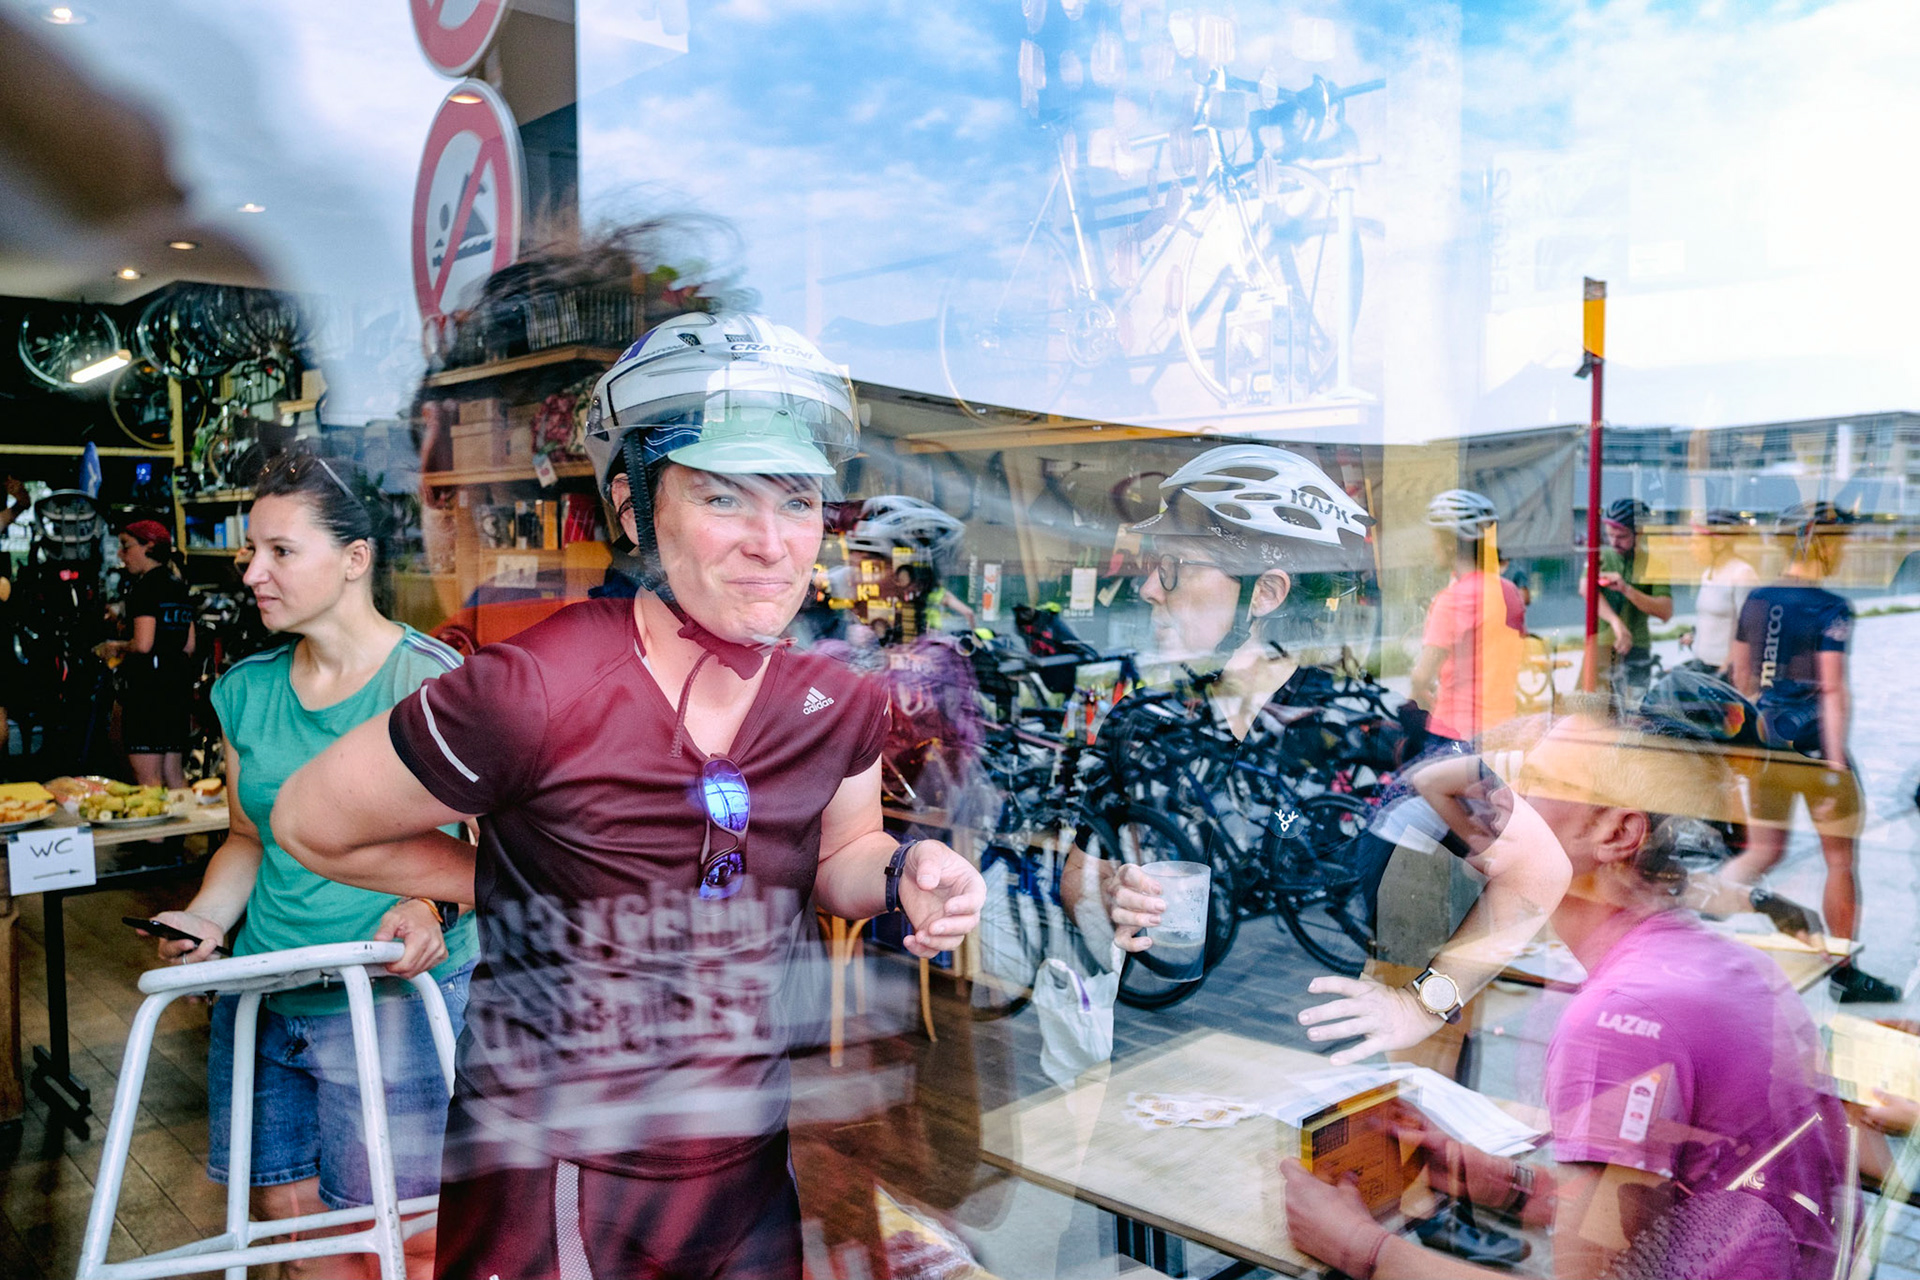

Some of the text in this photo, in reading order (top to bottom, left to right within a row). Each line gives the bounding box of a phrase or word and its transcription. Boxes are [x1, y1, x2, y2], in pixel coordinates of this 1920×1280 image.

[1760, 604, 1784, 688] marco
[802, 697, 835, 715] adidas
[29, 837, 74, 858] WC
[1596, 1010, 1663, 1040] LAZER
